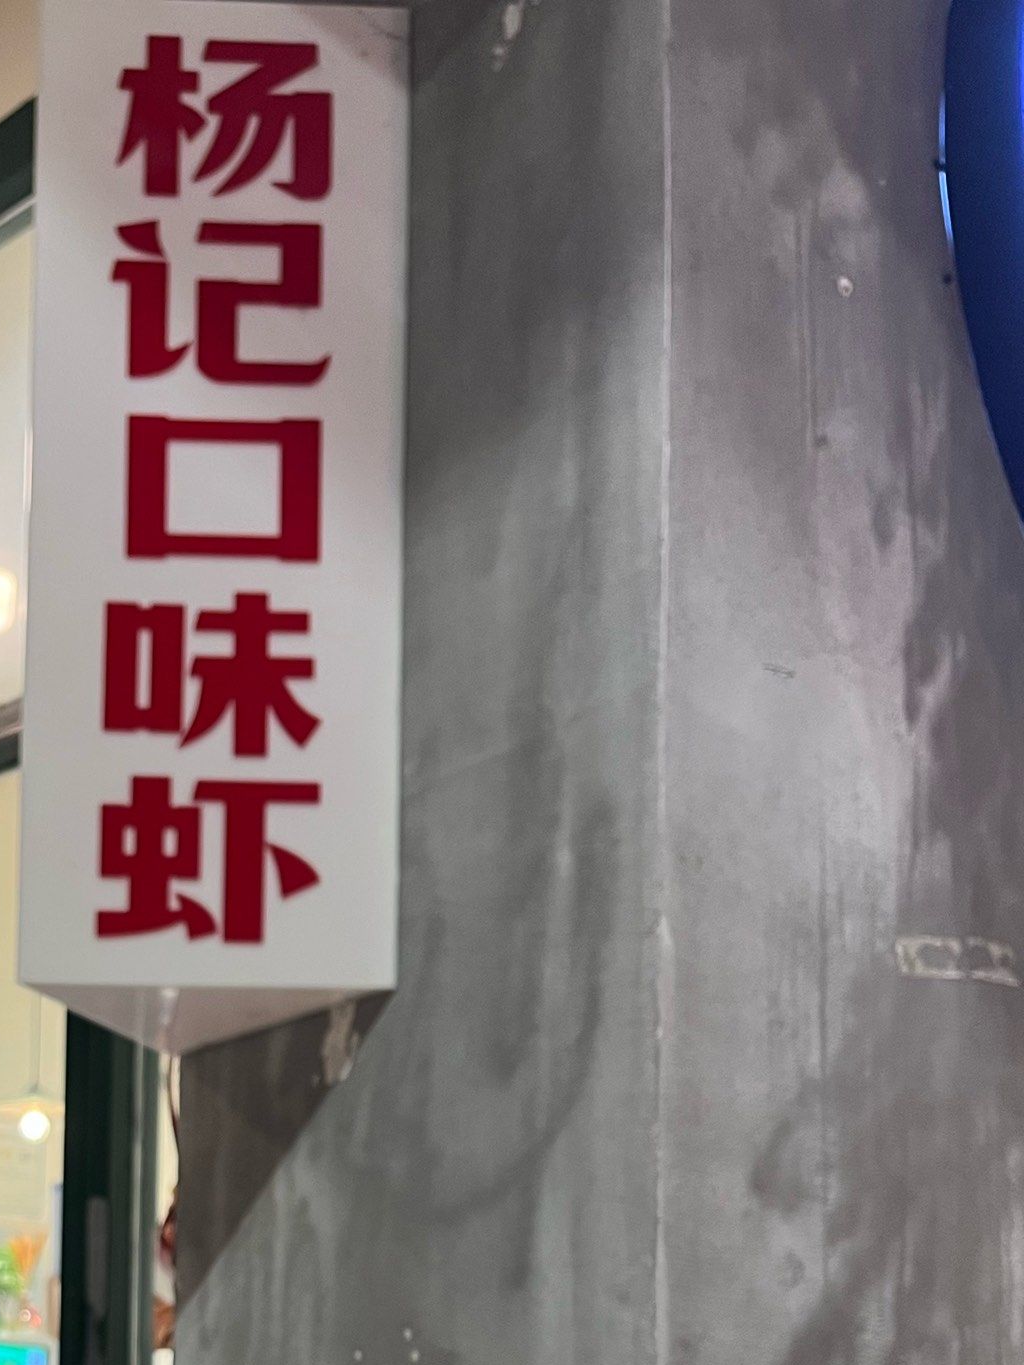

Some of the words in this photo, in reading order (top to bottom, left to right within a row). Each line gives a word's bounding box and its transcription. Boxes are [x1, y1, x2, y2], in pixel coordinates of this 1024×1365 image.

[95, 35, 333, 944] 杨记口味虾
